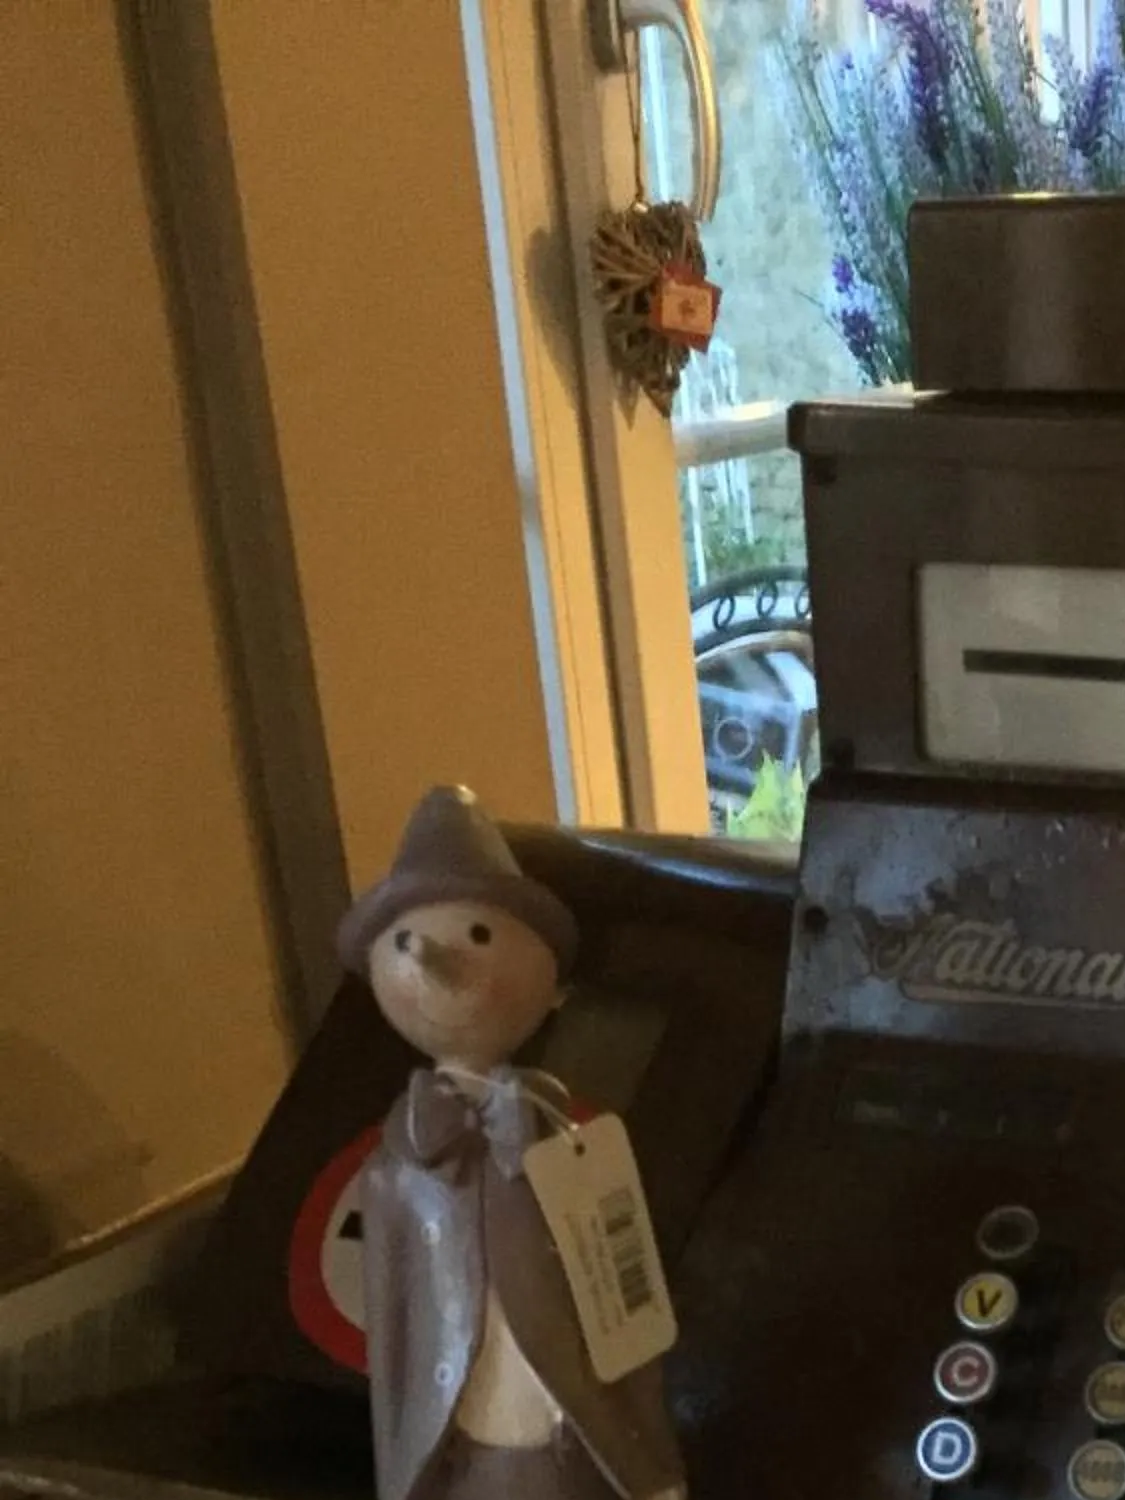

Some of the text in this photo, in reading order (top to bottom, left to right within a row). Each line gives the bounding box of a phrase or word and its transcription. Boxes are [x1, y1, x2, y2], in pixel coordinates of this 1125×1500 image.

[976, 1287, 1003, 1318] V
[952, 1359, 981, 1388] C
[931, 1431, 963, 1466] D
